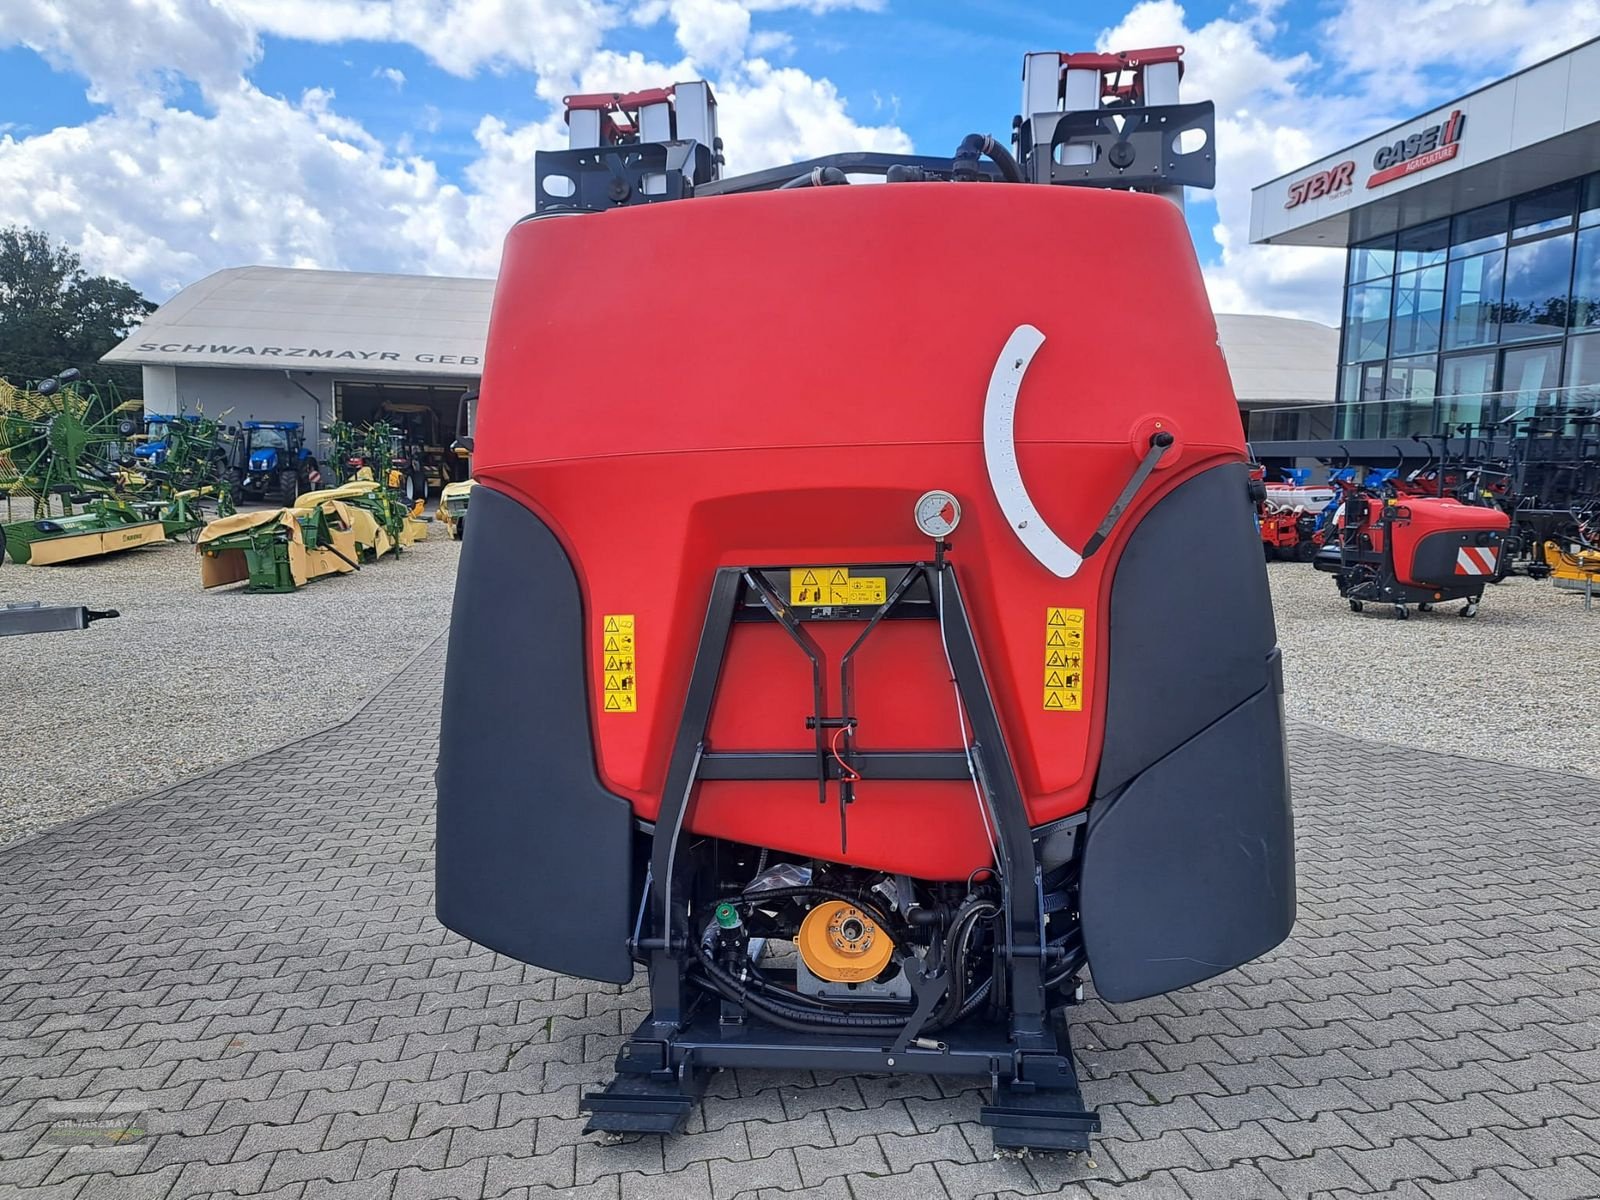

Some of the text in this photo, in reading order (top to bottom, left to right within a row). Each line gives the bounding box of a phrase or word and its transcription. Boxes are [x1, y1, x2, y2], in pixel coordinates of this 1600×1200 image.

[1405, 146, 1454, 172] AGRICULTURE
[1285, 160, 1355, 209] STEYR
[137, 343, 479, 365] SCHWARZMAYR GEB
